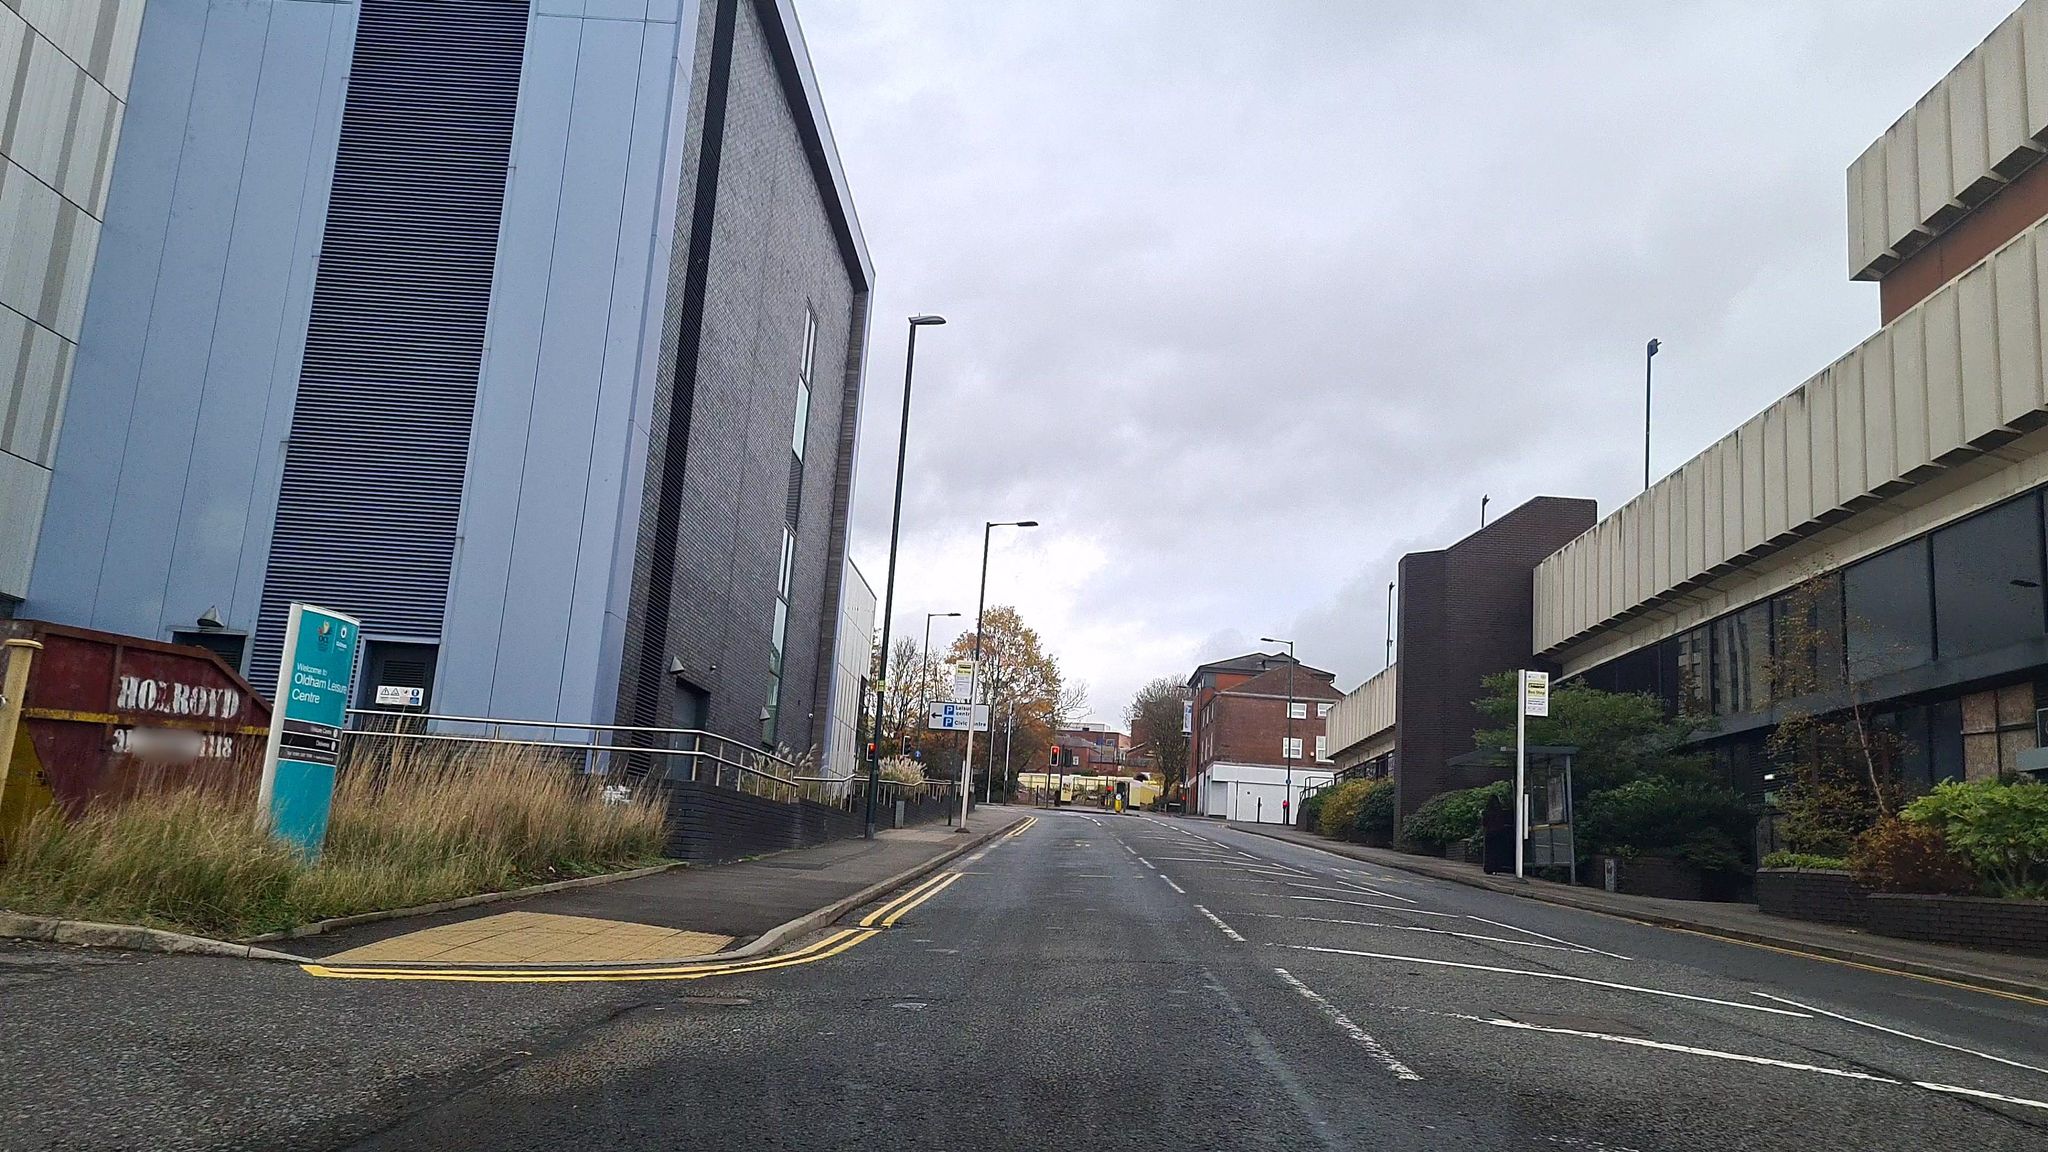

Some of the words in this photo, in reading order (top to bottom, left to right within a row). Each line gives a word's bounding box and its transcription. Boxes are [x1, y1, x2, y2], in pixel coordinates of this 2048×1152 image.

[296, 662, 322, 675] Welcome
[295, 672, 327, 689] Oldham
[327, 679, 348, 695] Leisure
[292, 688, 321, 704] Centre
